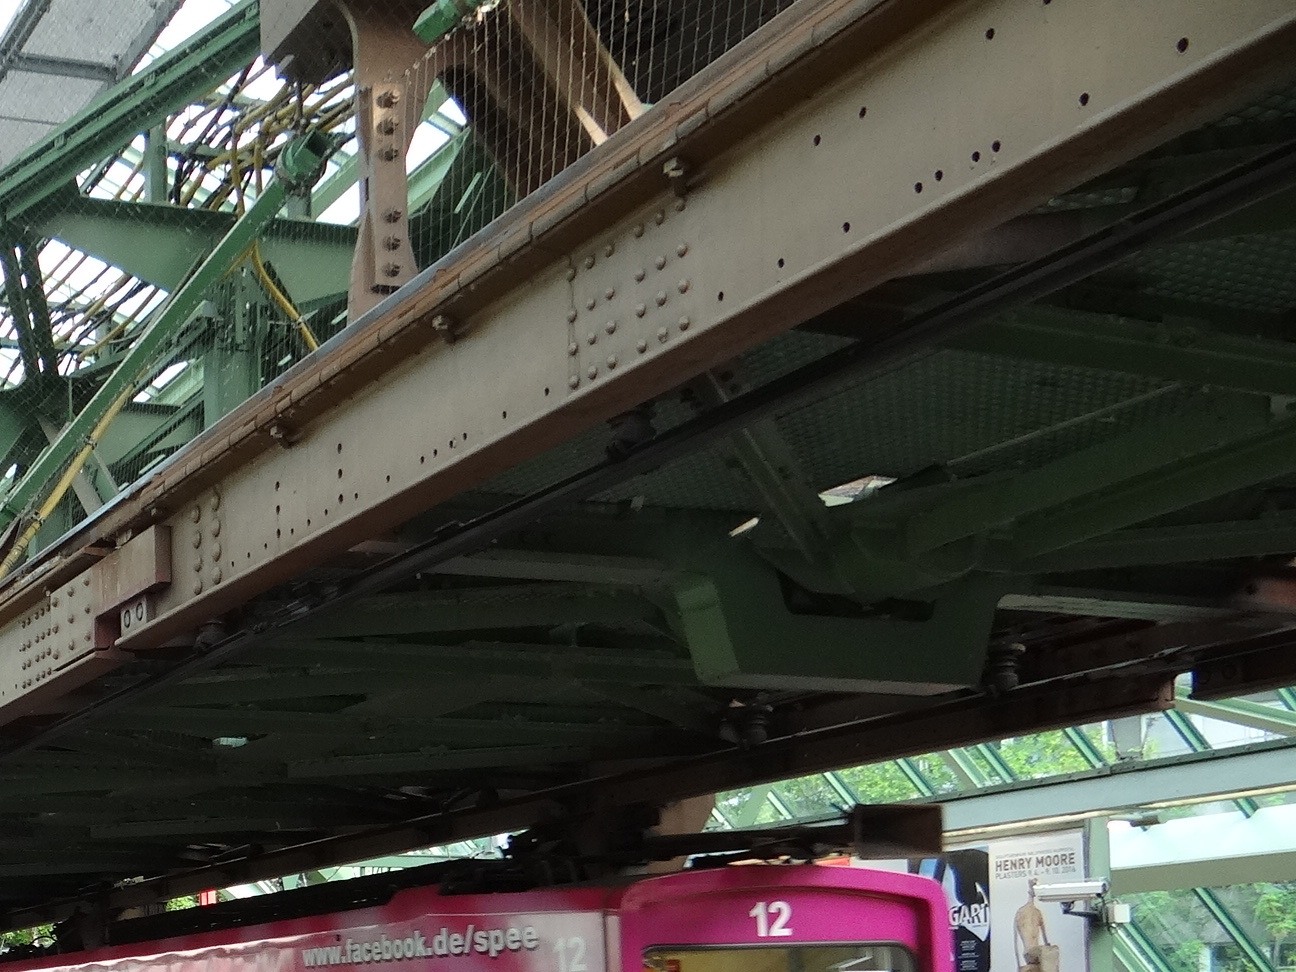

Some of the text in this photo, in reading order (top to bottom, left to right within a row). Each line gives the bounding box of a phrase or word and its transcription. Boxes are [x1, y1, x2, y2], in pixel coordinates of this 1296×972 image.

[995, 857, 1031, 872] HENRY
[1035, 853, 1075, 868] MOORE
[995, 870, 1027, 879] PLASTERS
[749, 901, 793, 937] 12
[303, 924, 540, 967] www.facebook.de/spee
[553, 936, 588, 972] 12
